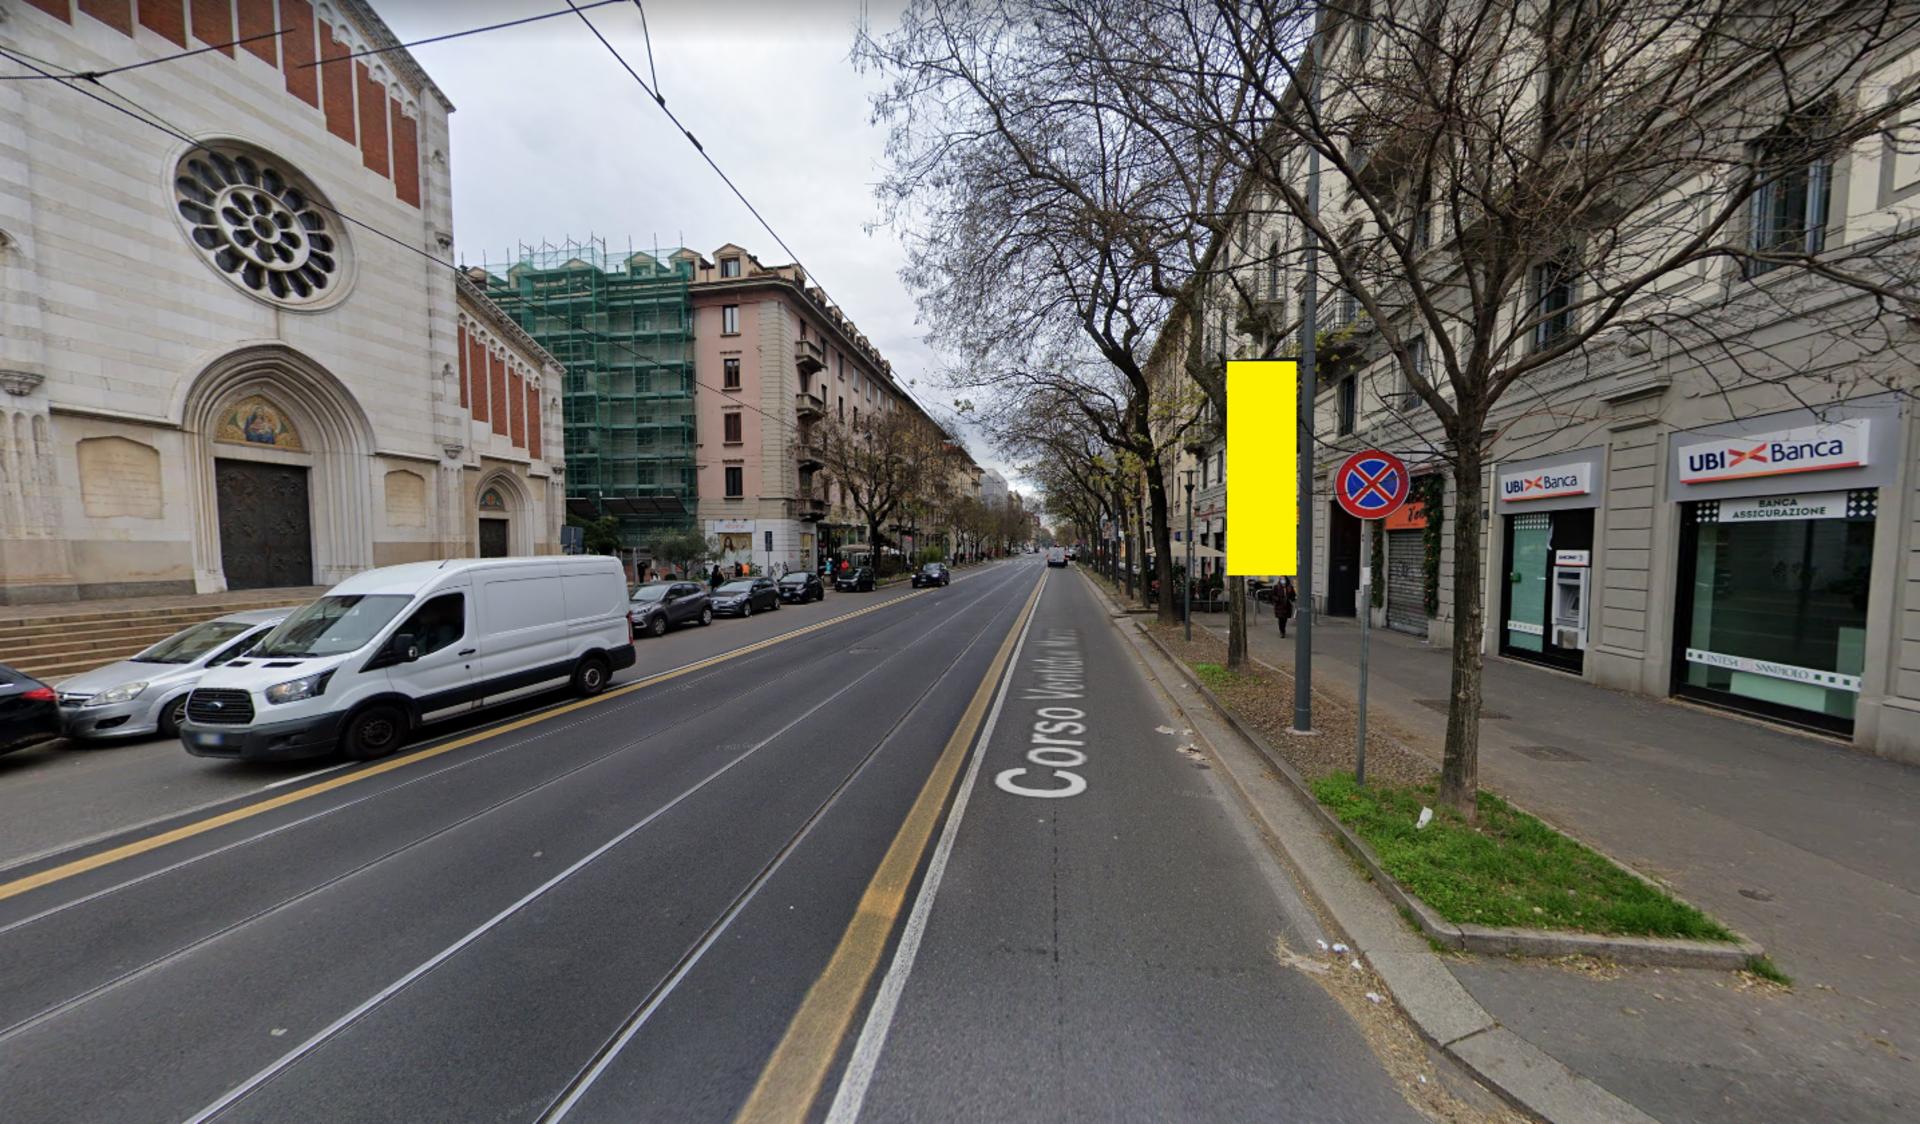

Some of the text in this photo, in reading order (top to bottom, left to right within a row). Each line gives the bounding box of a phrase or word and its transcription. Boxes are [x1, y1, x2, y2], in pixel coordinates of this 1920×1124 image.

[1689, 439, 1843, 472] UBI Banca
[1505, 475, 1577, 494] UBI Banca
[1758, 497, 1798, 508] BANCA
[1732, 506, 1827, 519] ASSICURAZIONE
